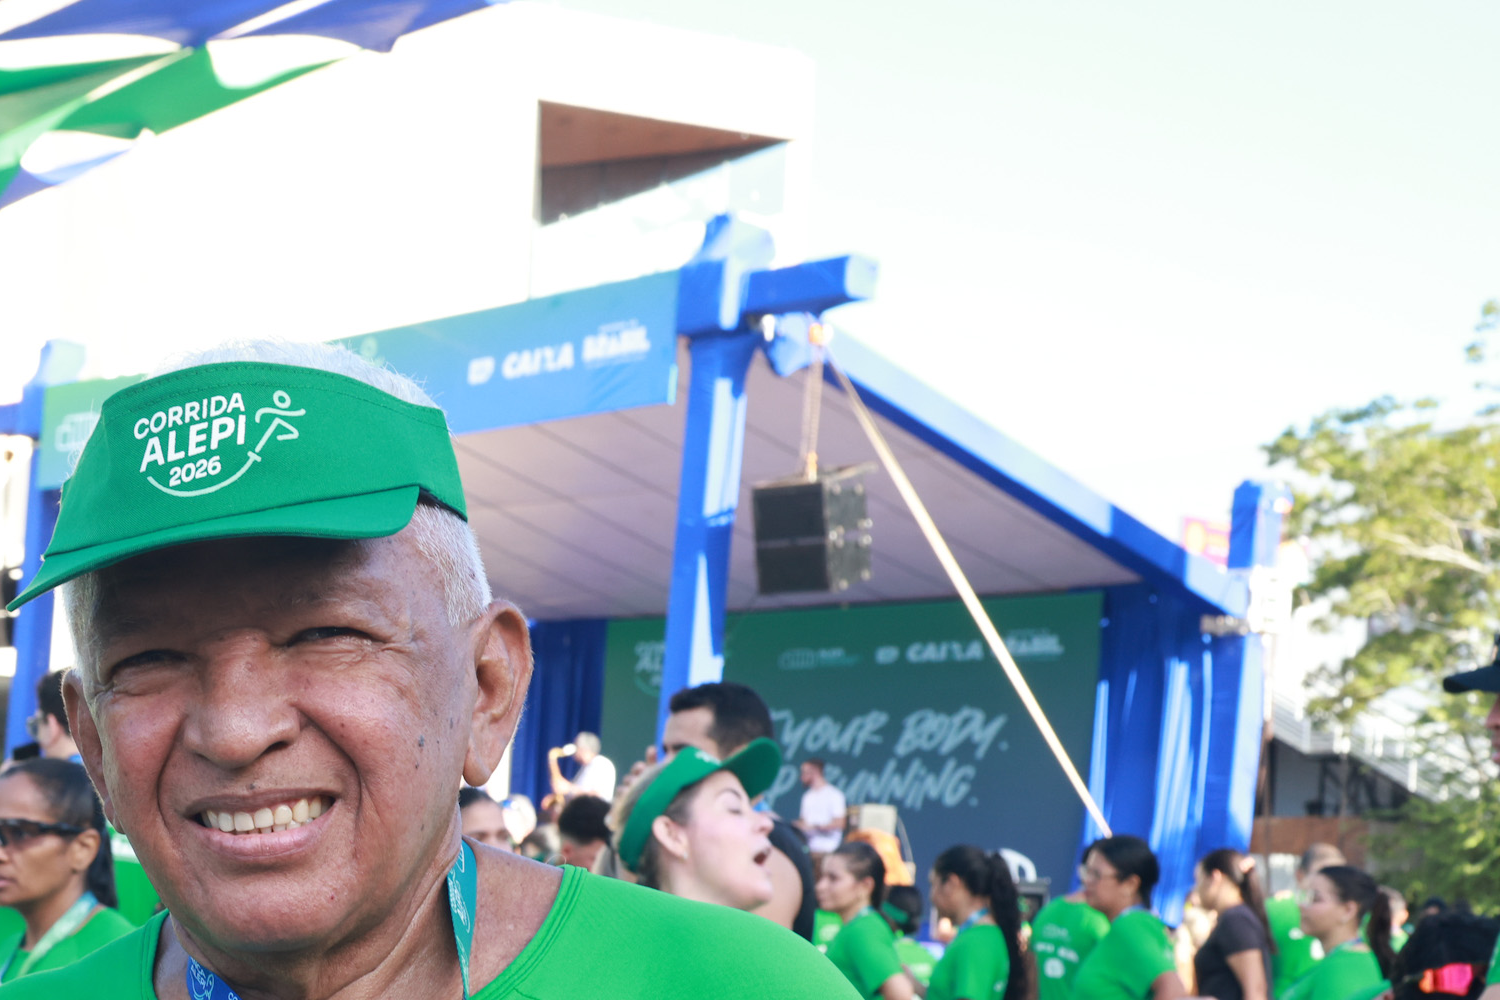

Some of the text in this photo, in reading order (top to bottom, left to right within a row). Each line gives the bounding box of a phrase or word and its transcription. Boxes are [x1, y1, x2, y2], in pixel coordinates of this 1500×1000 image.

[502, 341, 575, 380] CAIXA
[133, 392, 246, 440] CORRIDA
[139, 414, 247, 473] ALEPI
[169, 455, 222, 487] 2026
